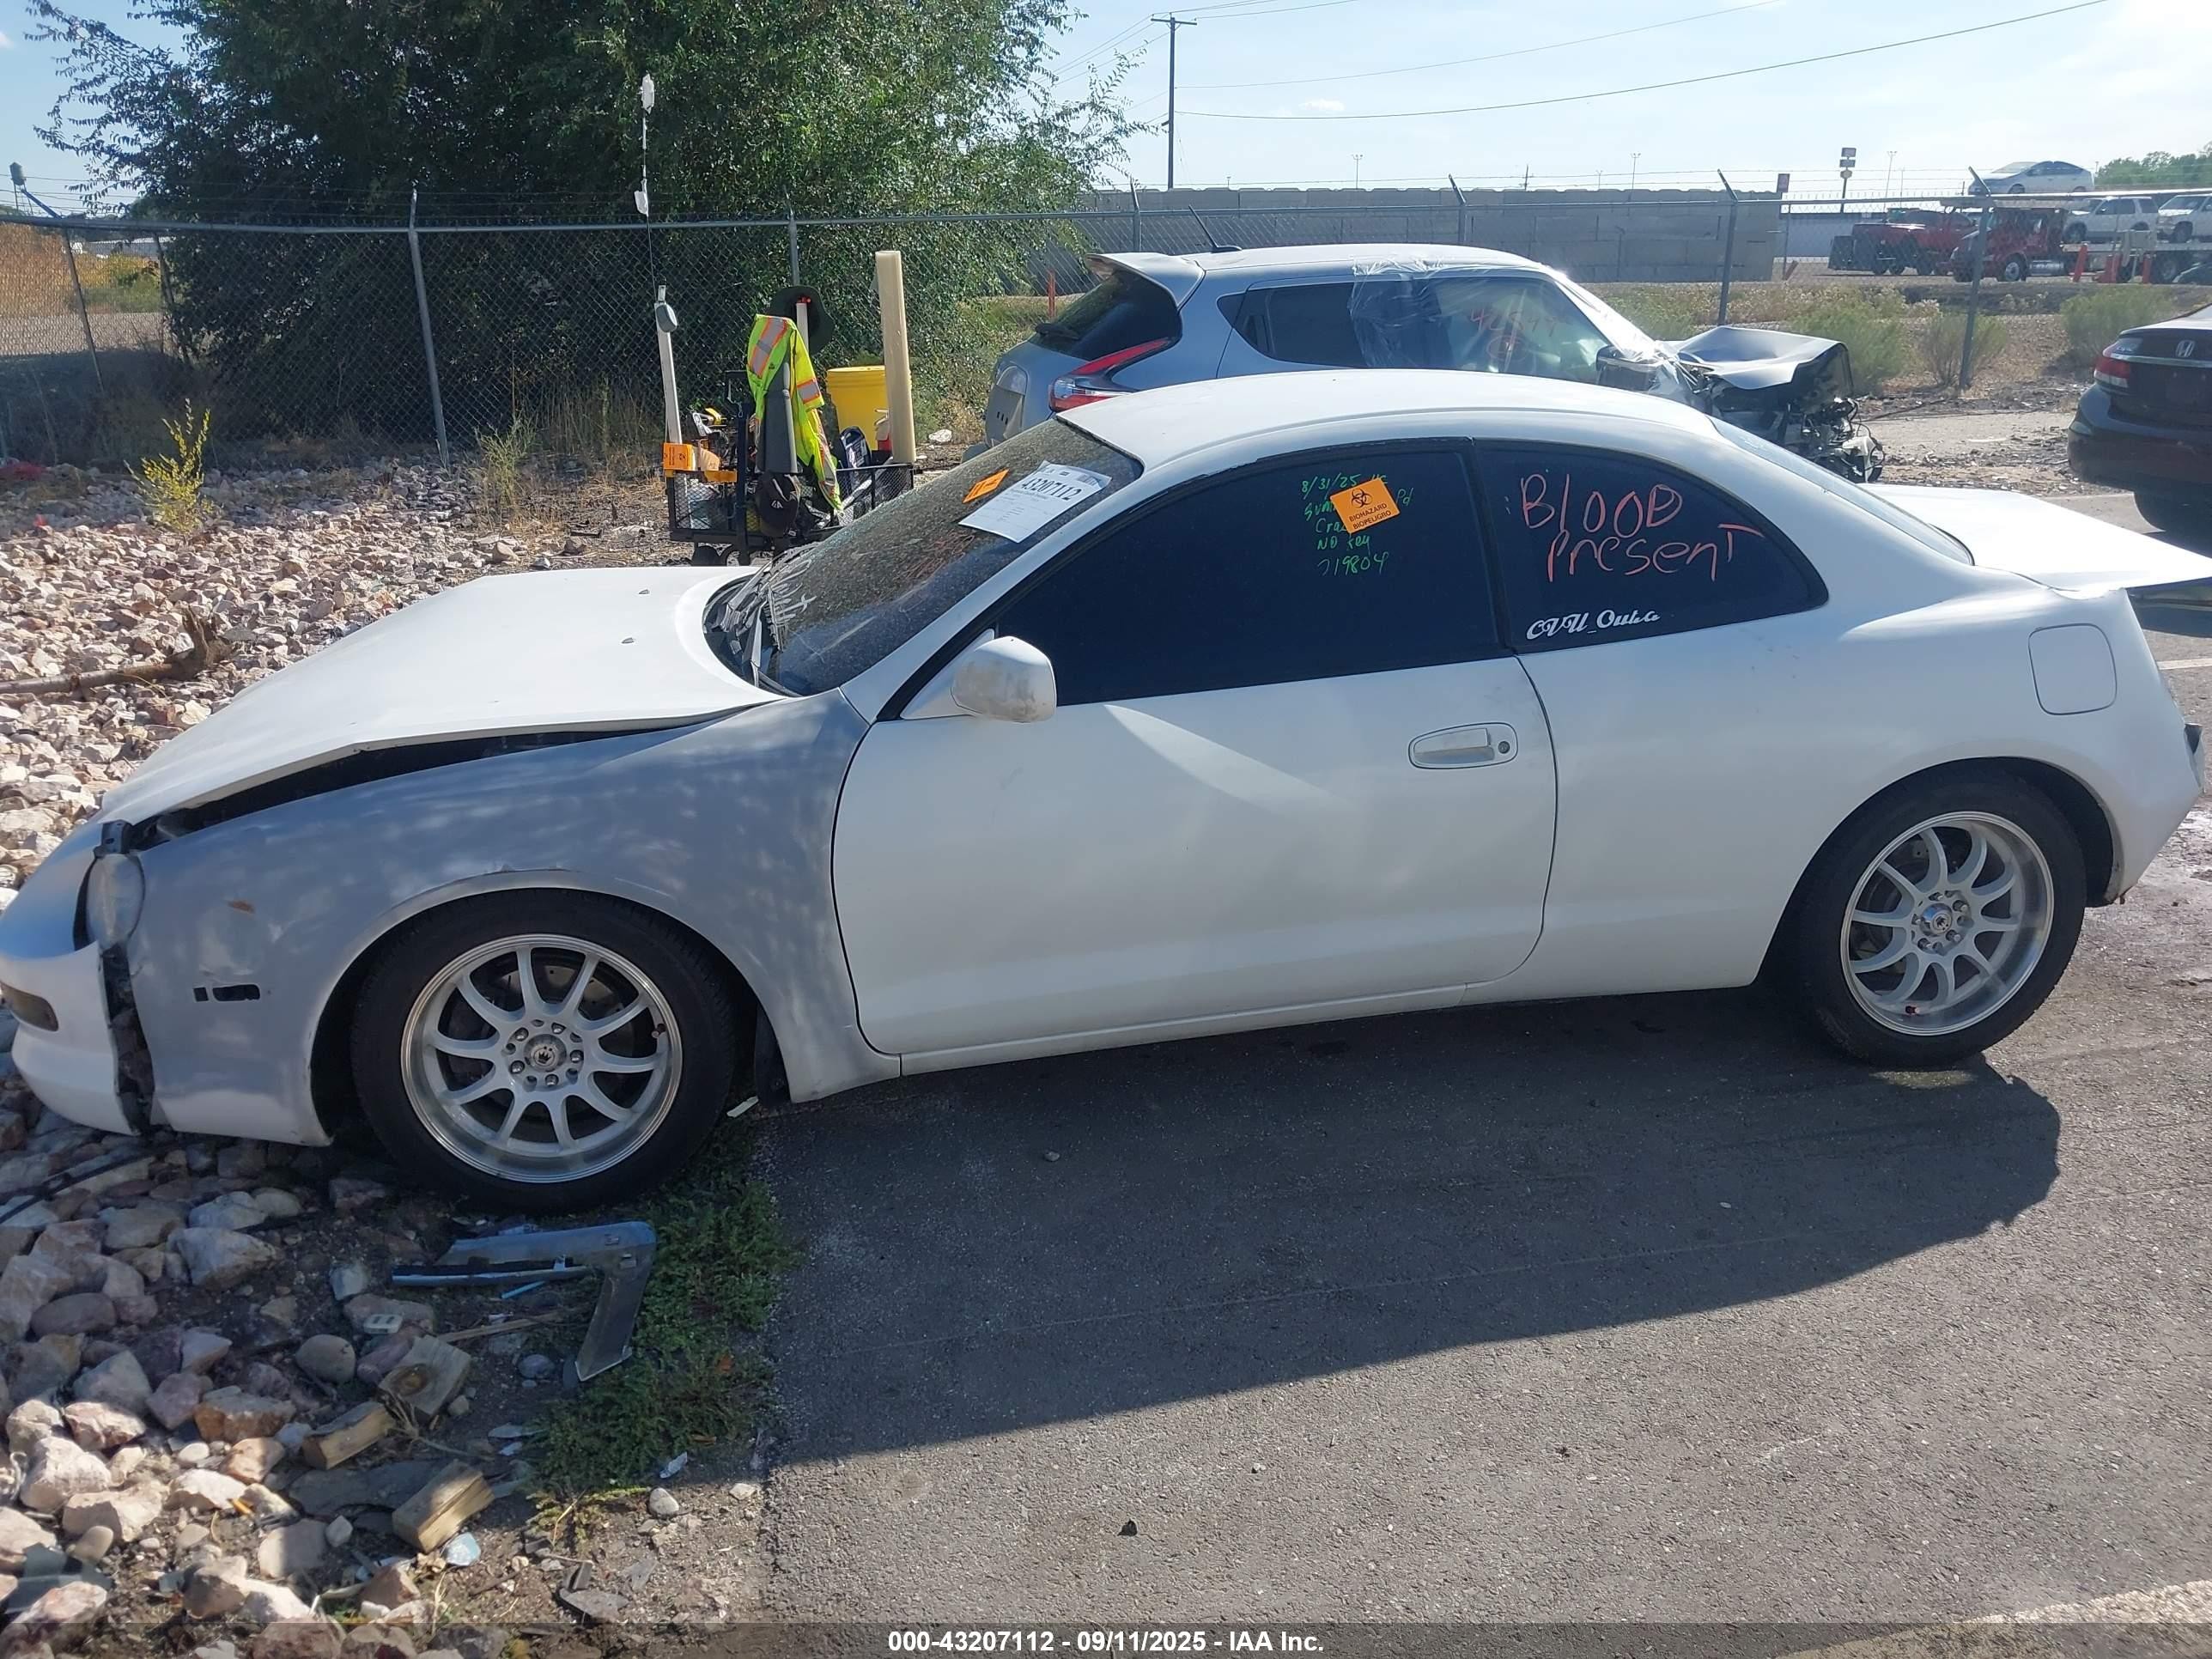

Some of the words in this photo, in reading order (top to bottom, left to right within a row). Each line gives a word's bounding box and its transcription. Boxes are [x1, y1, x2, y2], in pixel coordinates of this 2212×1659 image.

[1302, 472, 1361, 500] 8/31/25
[1348, 502, 1388, 522] BIOHAZARD
[1352, 510, 1392, 530] BIOPELIGRO
